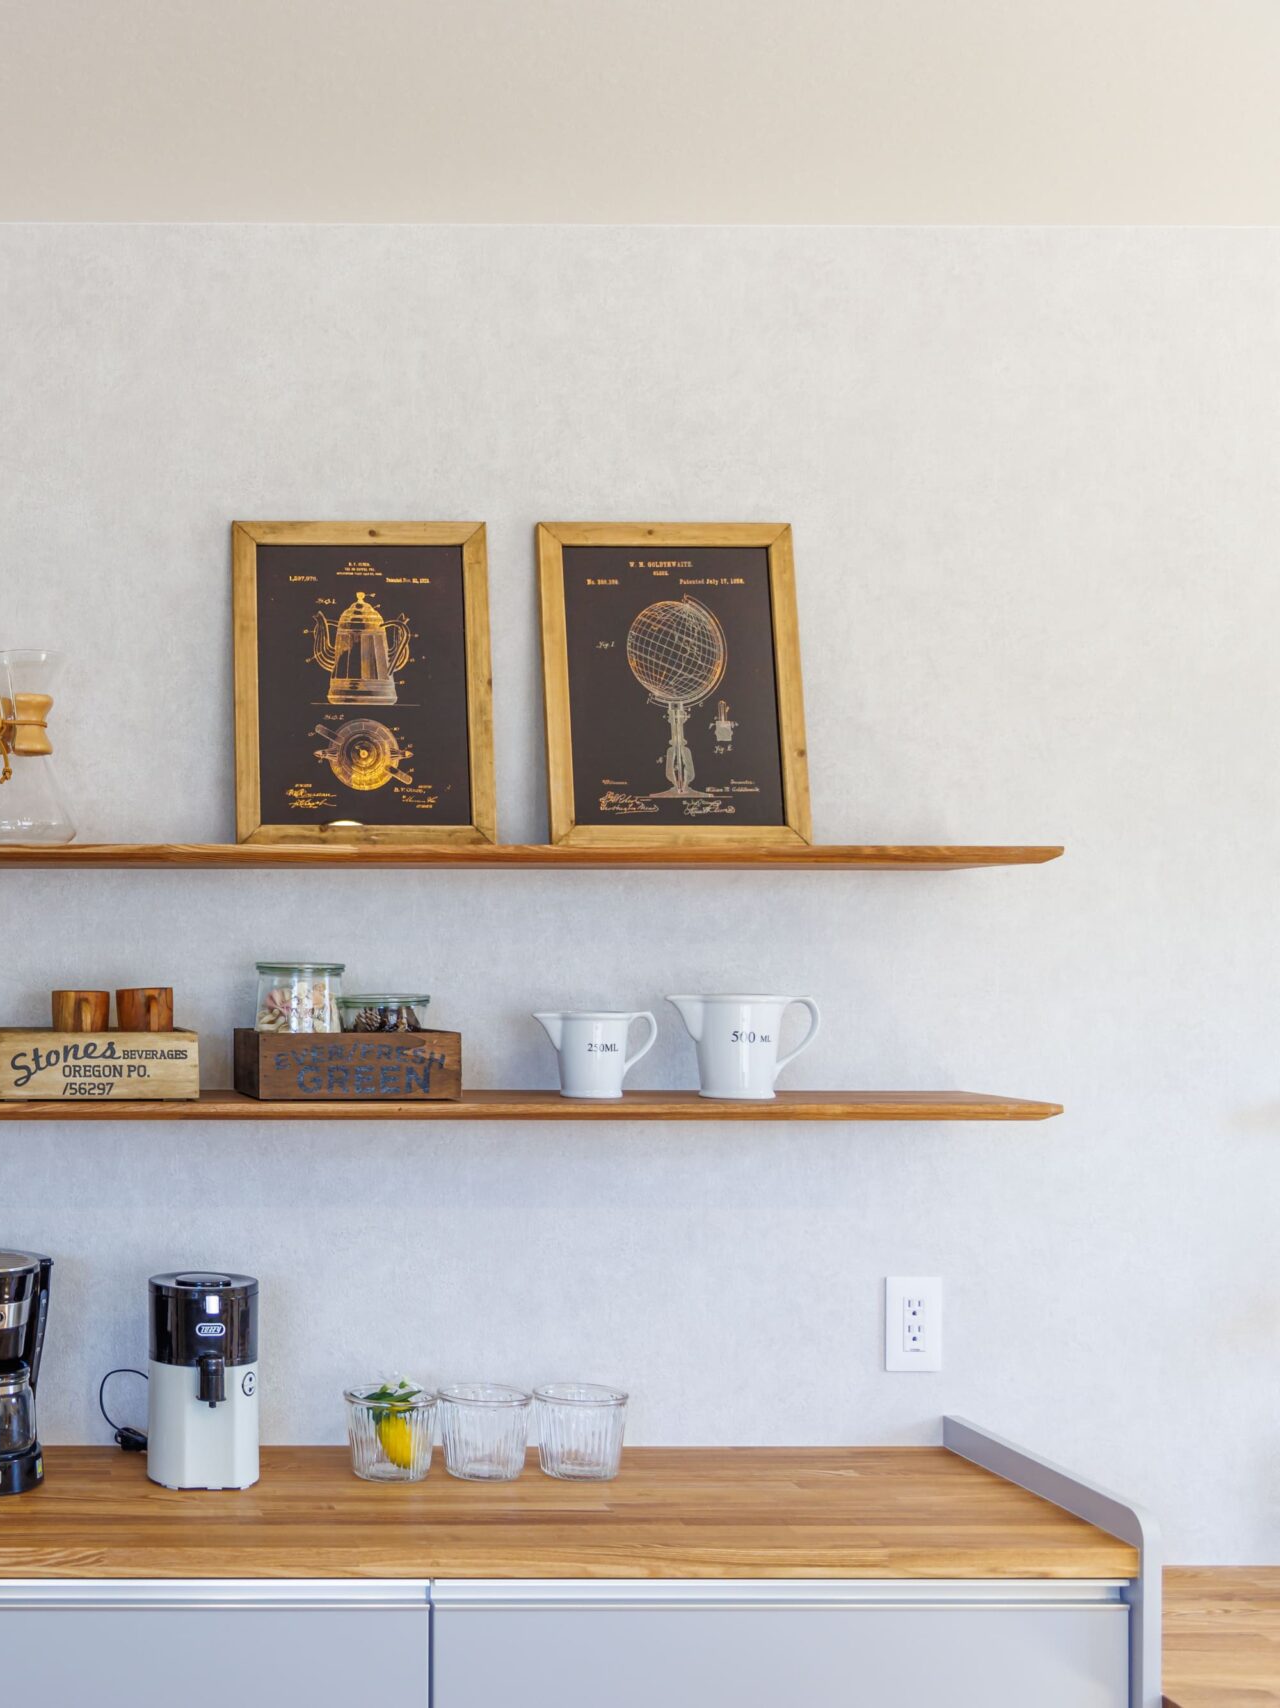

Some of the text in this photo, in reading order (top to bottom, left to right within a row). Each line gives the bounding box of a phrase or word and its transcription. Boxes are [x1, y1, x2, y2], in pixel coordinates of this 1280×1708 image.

[731, 1030, 773, 1044] 500 ML
[587, 1042, 619, 1053] 250ML
[10, 1041, 188, 1087] Stones BEVERAGES
[62, 1064, 151, 1079] OREGON PO.
[297, 1064, 431, 1094] GREEN
[62, 1082, 115, 1096] /56297
